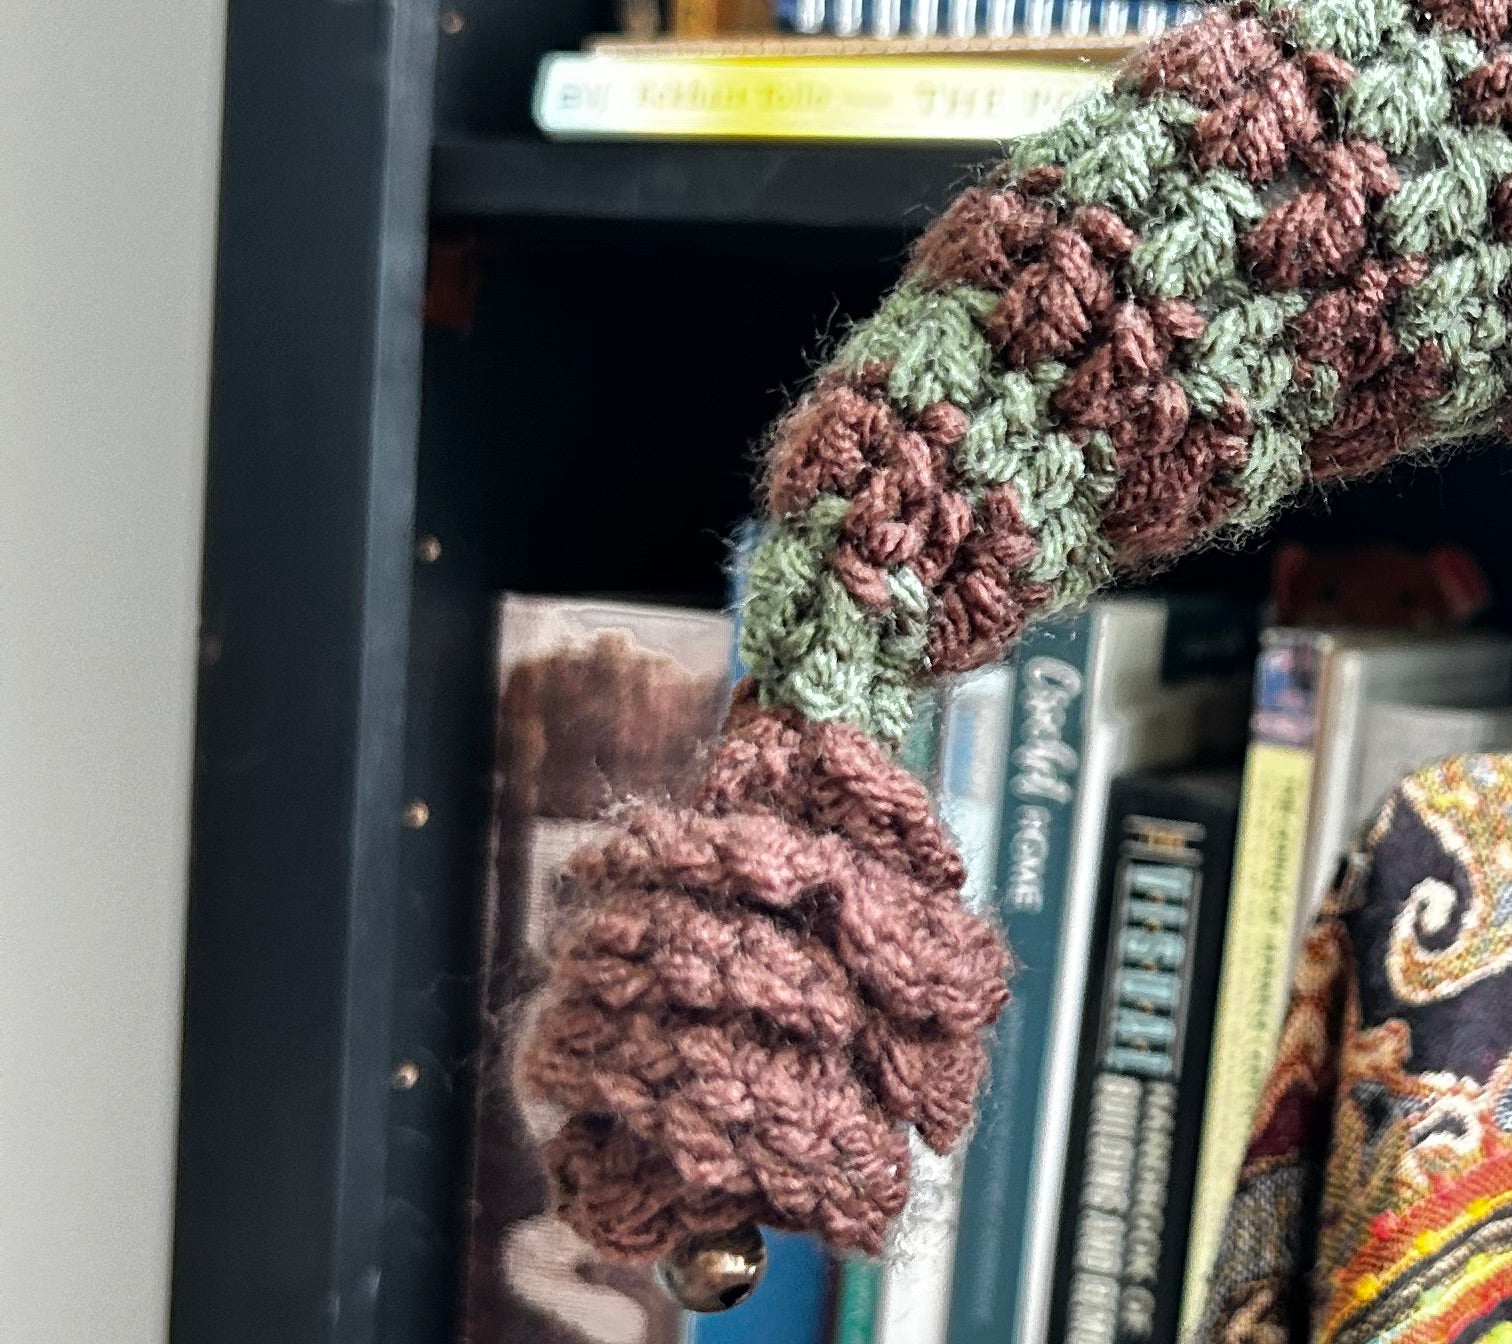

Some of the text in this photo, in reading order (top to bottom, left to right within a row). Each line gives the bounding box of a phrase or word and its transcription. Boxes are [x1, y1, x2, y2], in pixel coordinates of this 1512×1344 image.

[1005, 802, 1054, 915] HOME
[1108, 863, 1192, 1079] VISUAL
[1075, 1209, 1129, 1277] AND
[1117, 1080, 1179, 1339] HANDBOOK OF
